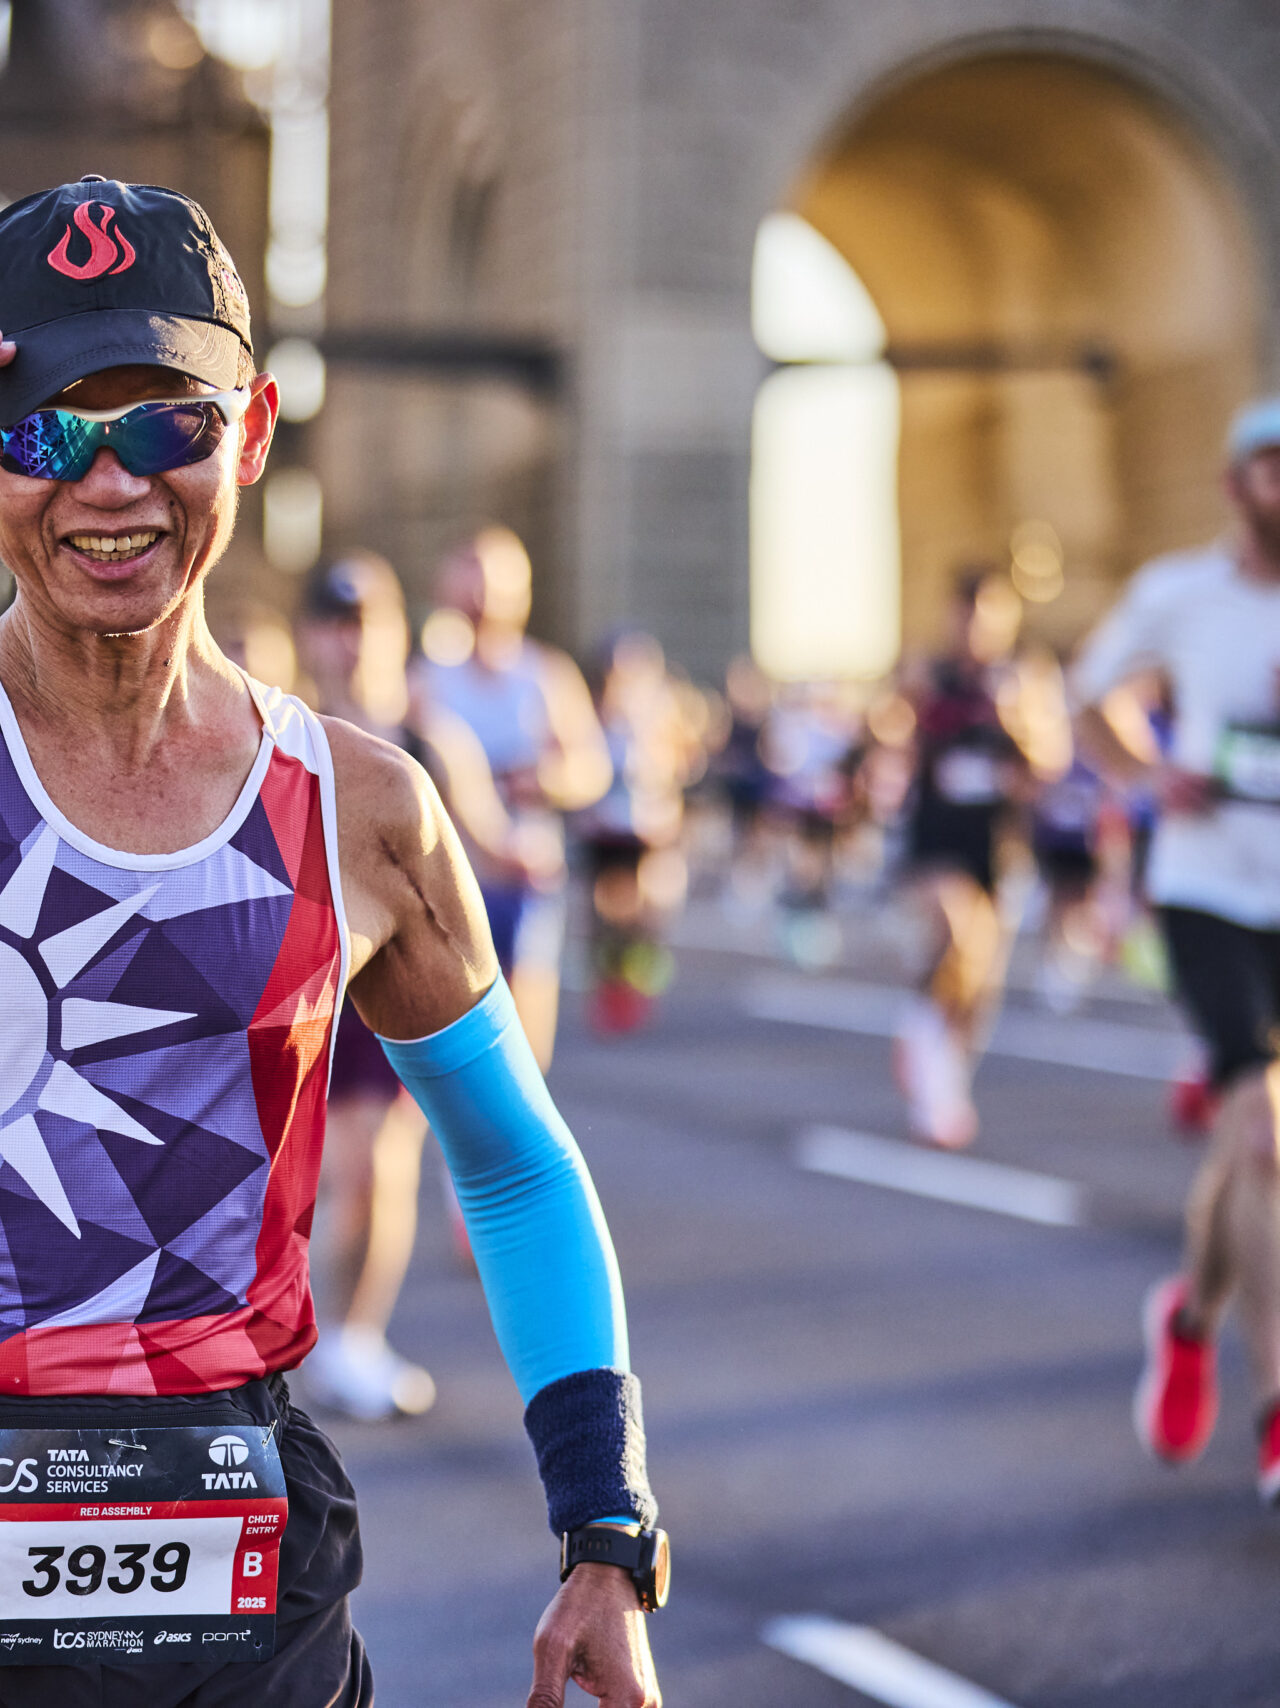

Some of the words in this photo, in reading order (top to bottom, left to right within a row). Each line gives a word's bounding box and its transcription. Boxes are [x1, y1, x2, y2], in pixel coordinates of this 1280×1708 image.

[47, 1449, 90, 1462] TATA
[46, 1464, 144, 1478] CONSULTANCY
[46, 1480, 109, 1493] SERVICES
[201, 1471, 258, 1490] TATA
[80, 1507, 100, 1517] RED
[101, 1506, 153, 1516] ASSEMBLY
[247, 1514, 280, 1525] CHUTE
[245, 1525, 278, 1535] ENTRY
[21, 1541, 191, 1598] 3939
[242, 1551, 263, 1577] B
[237, 1597, 267, 1609] 2025
[0, 1636, 17, 1644] new
[17, 1636, 43, 1645] sydney
[53, 1628, 86, 1649] tcs
[86, 1631, 124, 1640] SYDNEY
[166, 1632, 192, 1643] asics
[86, 1639, 144, 1648] MARATHON
